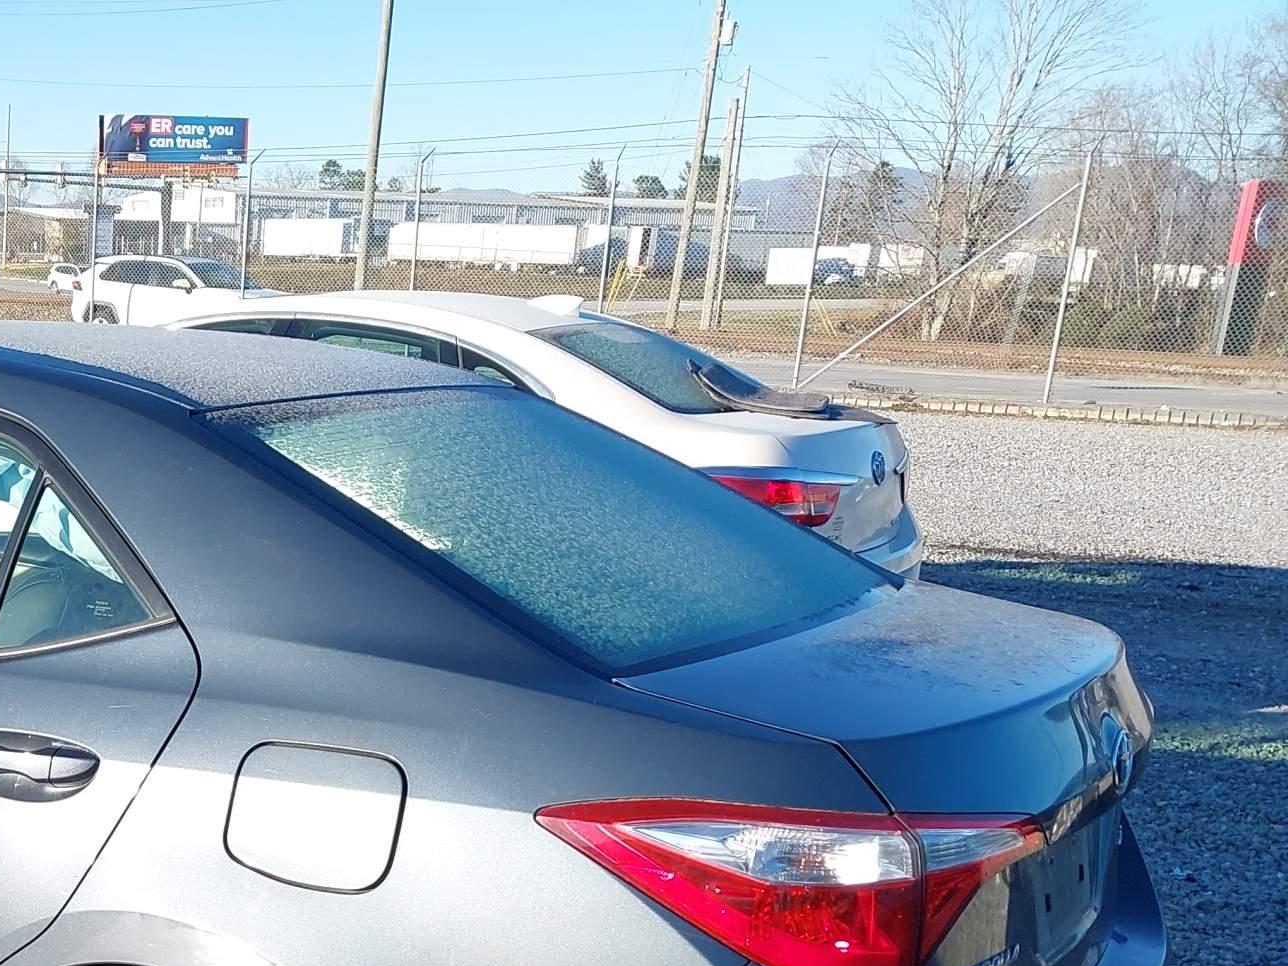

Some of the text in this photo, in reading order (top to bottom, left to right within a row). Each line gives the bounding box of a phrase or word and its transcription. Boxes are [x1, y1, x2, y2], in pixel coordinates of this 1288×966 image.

[151, 118, 234, 138] ER care you
[149, 136, 212, 149] can trust.
